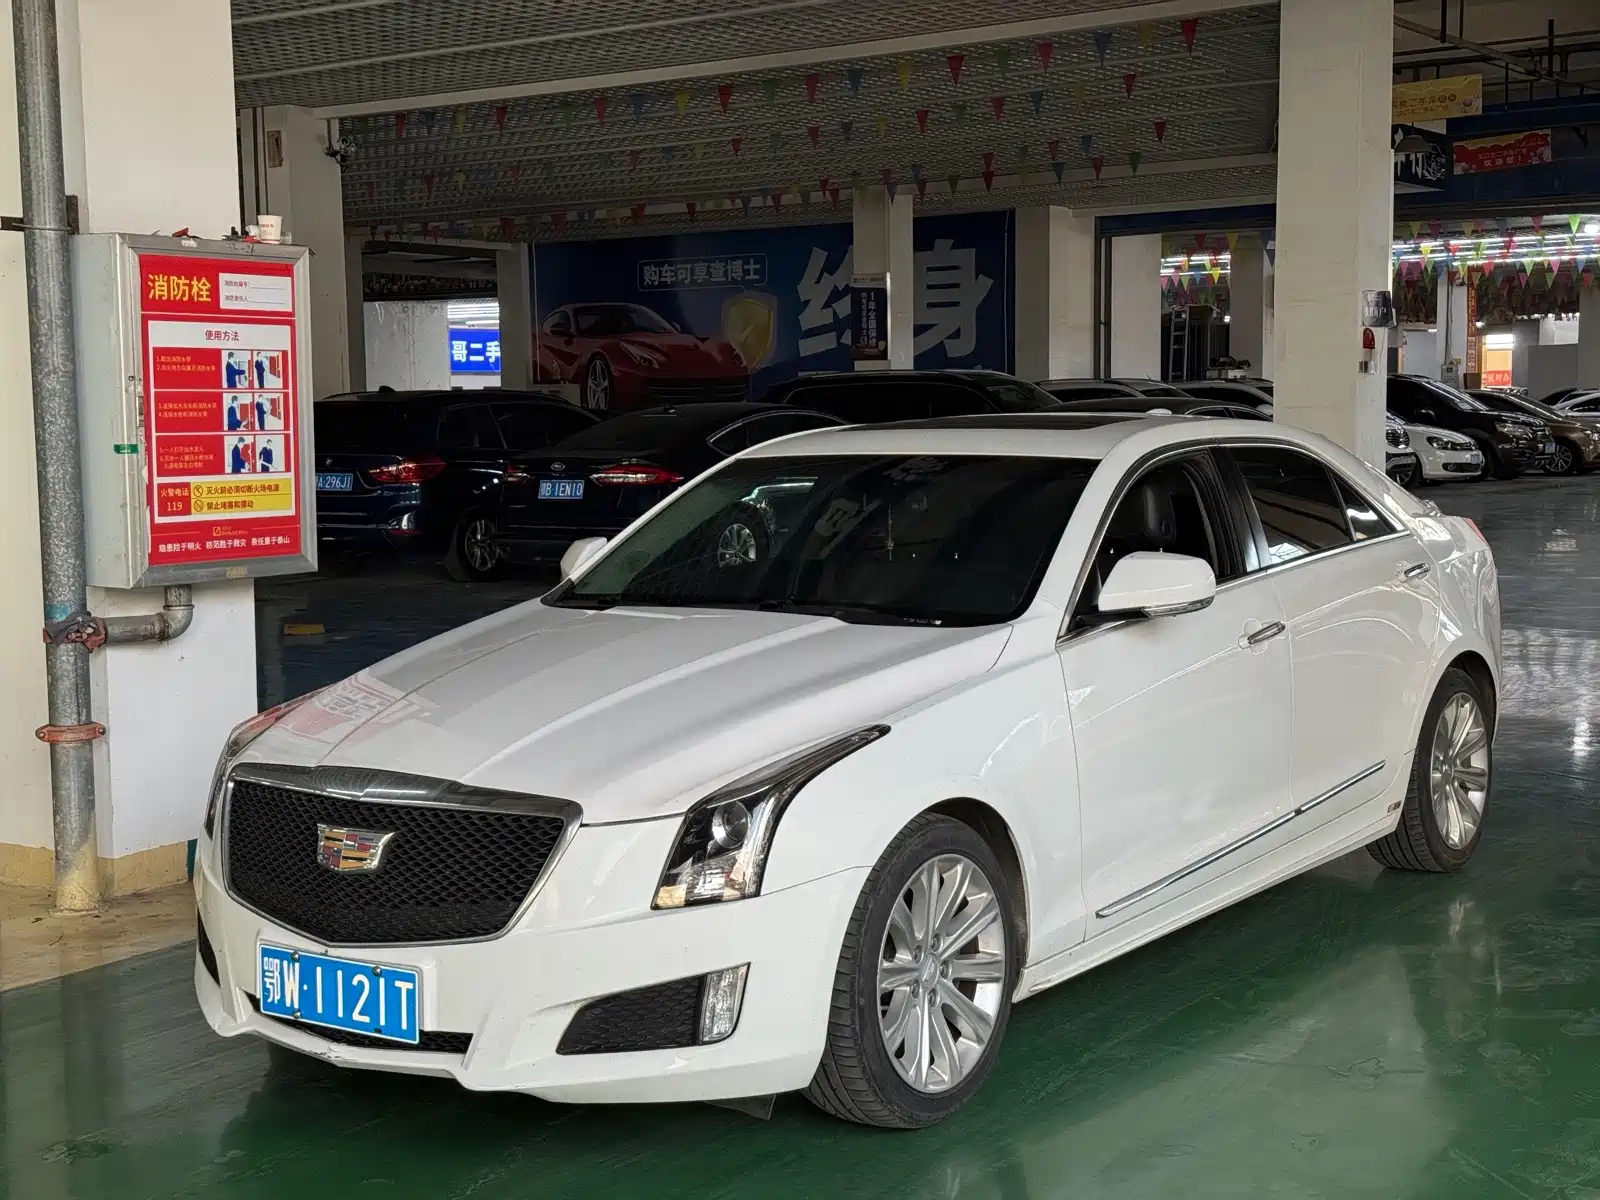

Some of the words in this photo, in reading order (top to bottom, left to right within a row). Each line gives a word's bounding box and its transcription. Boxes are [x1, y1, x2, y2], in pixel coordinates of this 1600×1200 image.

[642, 258, 762, 287] 购车可享查博士
[147, 274, 212, 303] 消防栓
[205, 330, 240, 342] 使用方法
[316, 474, 352, 489] A·296J1
[160, 487, 190, 497] 火警电话
[206, 484, 280, 495] 灭火前必须切断火场电源
[166, 501, 183, 512] 119
[158, 541, 202, 553] 隐患险于明火
[206, 538, 247, 550] 防范胜于救灾
[263, 957, 414, 1030] 鄂W·1121T
